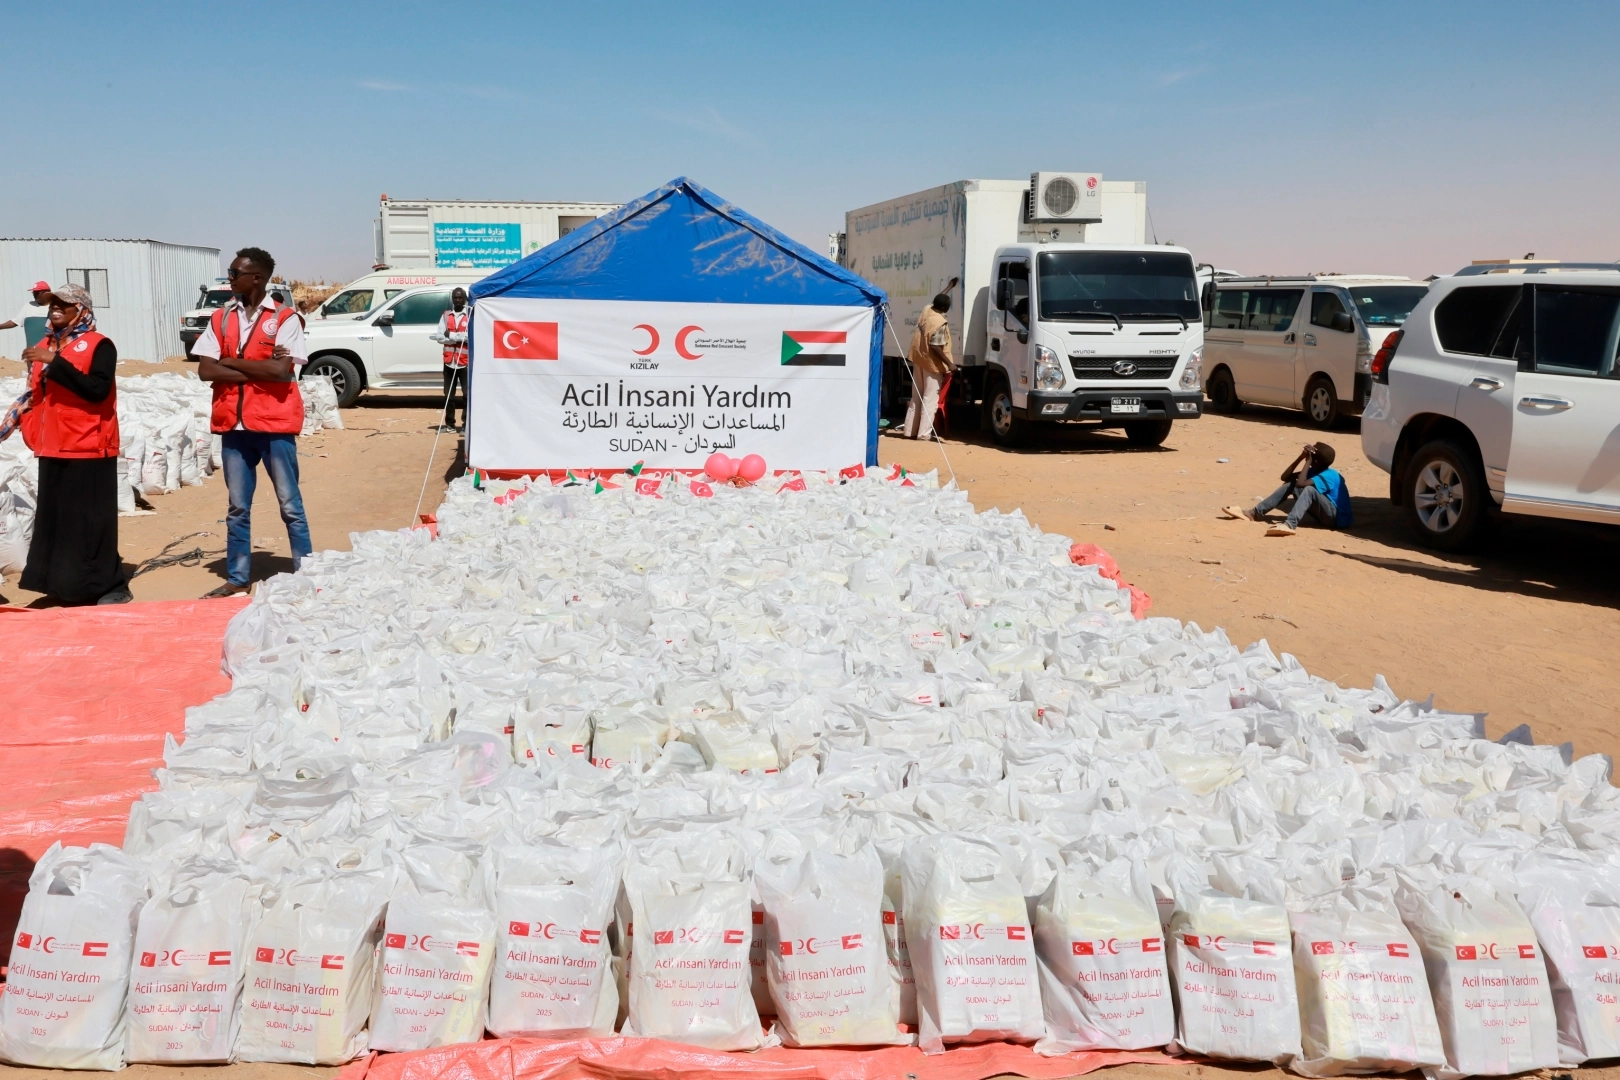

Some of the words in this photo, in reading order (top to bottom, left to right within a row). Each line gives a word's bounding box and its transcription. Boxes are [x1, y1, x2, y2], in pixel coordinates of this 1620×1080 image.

[561, 383, 609, 407] Acil
[619, 380, 694, 407] İnsani
[702, 384, 791, 408] Yardım
[562, 411, 617, 432] الطارئة
[626, 411, 694, 435] الإنسانية
[702, 413, 785, 431] المساعدات
[609, 439, 667, 452] SUDAN
[684, 433, 735, 454] السودان
[507, 950, 526, 961] Acil
[529, 951, 560, 965] İnsani
[562, 956, 596, 968] Yardım
[709, 959, 741, 969] Yardım
[945, 955, 963, 966] Acil
[966, 953, 994, 966] İnsani
[996, 955, 1027, 966] Yardım
[10, 962, 25, 975] Acil
[27, 964, 58, 980] İnsani
[61, 971, 100, 983] Yardım
[384, 963, 402, 975] Acil
[405, 963, 436, 978] İnsani
[439, 969, 472, 982] Yardım
[798, 968, 828, 980] İnsani
[830, 965, 865, 977] Yardım
[1078, 971, 1096, 982] Acil
[1100, 969, 1128, 981] İnsani
[1185, 961, 1204, 973] Acil
[1208, 962, 1237, 977] İnsani
[1240, 968, 1276, 982] Yardım
[1595, 972, 1612, 984] Acil
[135, 982, 152, 993] Acil
[156, 981, 188, 993] İnsani
[192, 981, 227, 992] Yardım
[254, 978, 271, 989] Acil
[274, 978, 300, 993] İnsani
[304, 984, 339, 996] Yardım
[1462, 977, 1479, 987] Acil
[1482, 974, 1509, 987] İnsani
[1510, 974, 1538, 986] Yardım
[17, 1008, 39, 1016] SUDAN
[1202, 1005, 1227, 1014] SUDAN
[31, 1027, 46, 1036] 2025
[819, 1026, 835, 1035] 2025
[1221, 1025, 1237, 1034] 2025
[281, 1040, 295, 1048] 2025
